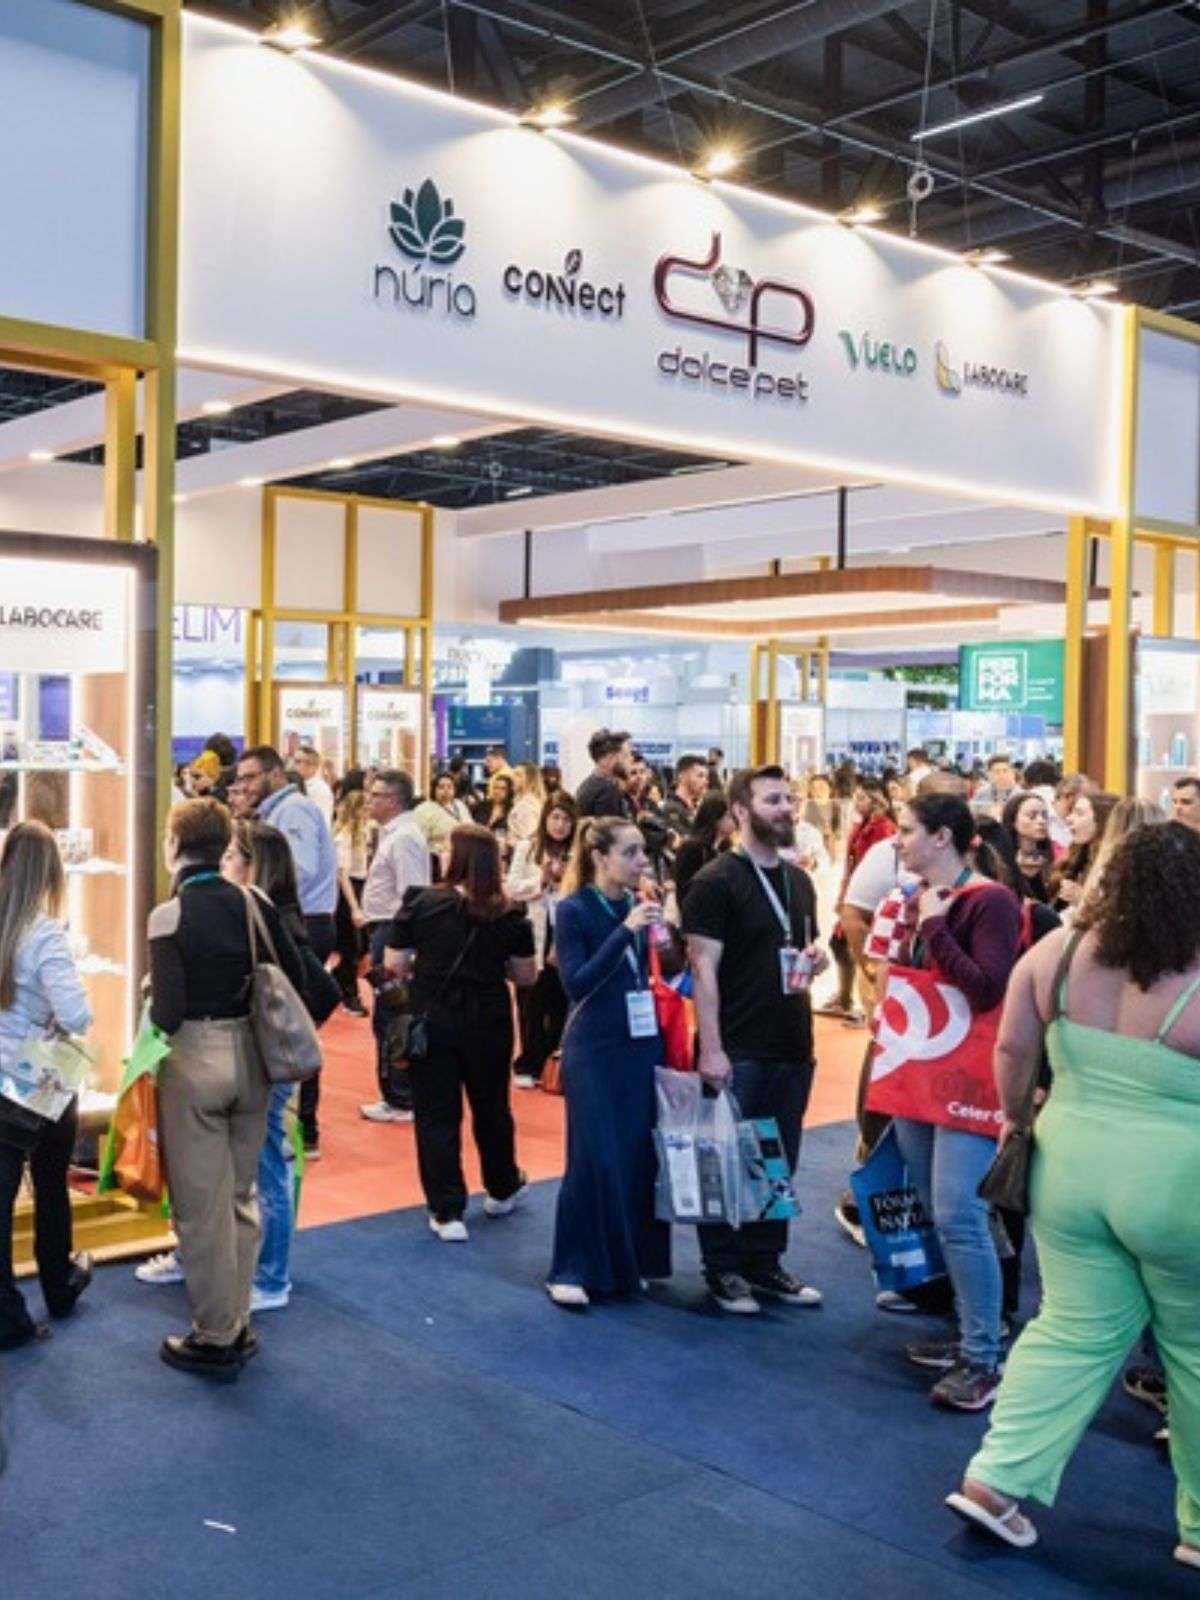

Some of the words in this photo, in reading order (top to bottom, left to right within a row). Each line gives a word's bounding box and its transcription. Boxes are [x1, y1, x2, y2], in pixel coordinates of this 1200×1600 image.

[374, 264, 476, 316] núria
[963, 361, 1029, 396] LABOCARE
[0, 606, 103, 630] LABOCARE
